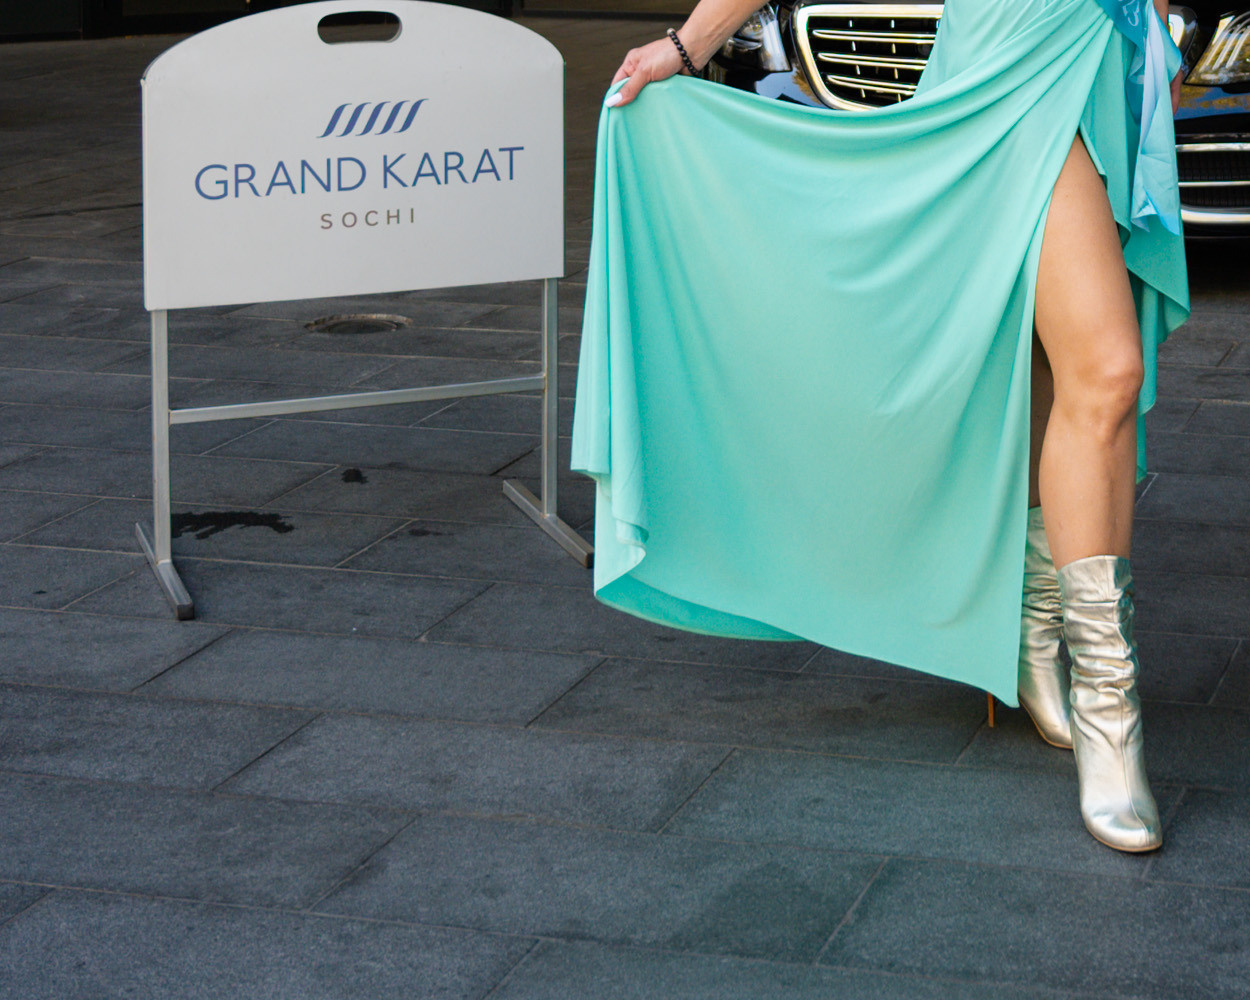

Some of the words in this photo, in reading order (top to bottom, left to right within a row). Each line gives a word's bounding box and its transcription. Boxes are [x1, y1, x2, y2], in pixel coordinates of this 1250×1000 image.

[194, 156, 367, 200] GRAND
[383, 146, 524, 189] KARAT
[320, 208, 415, 230] SOCHI
